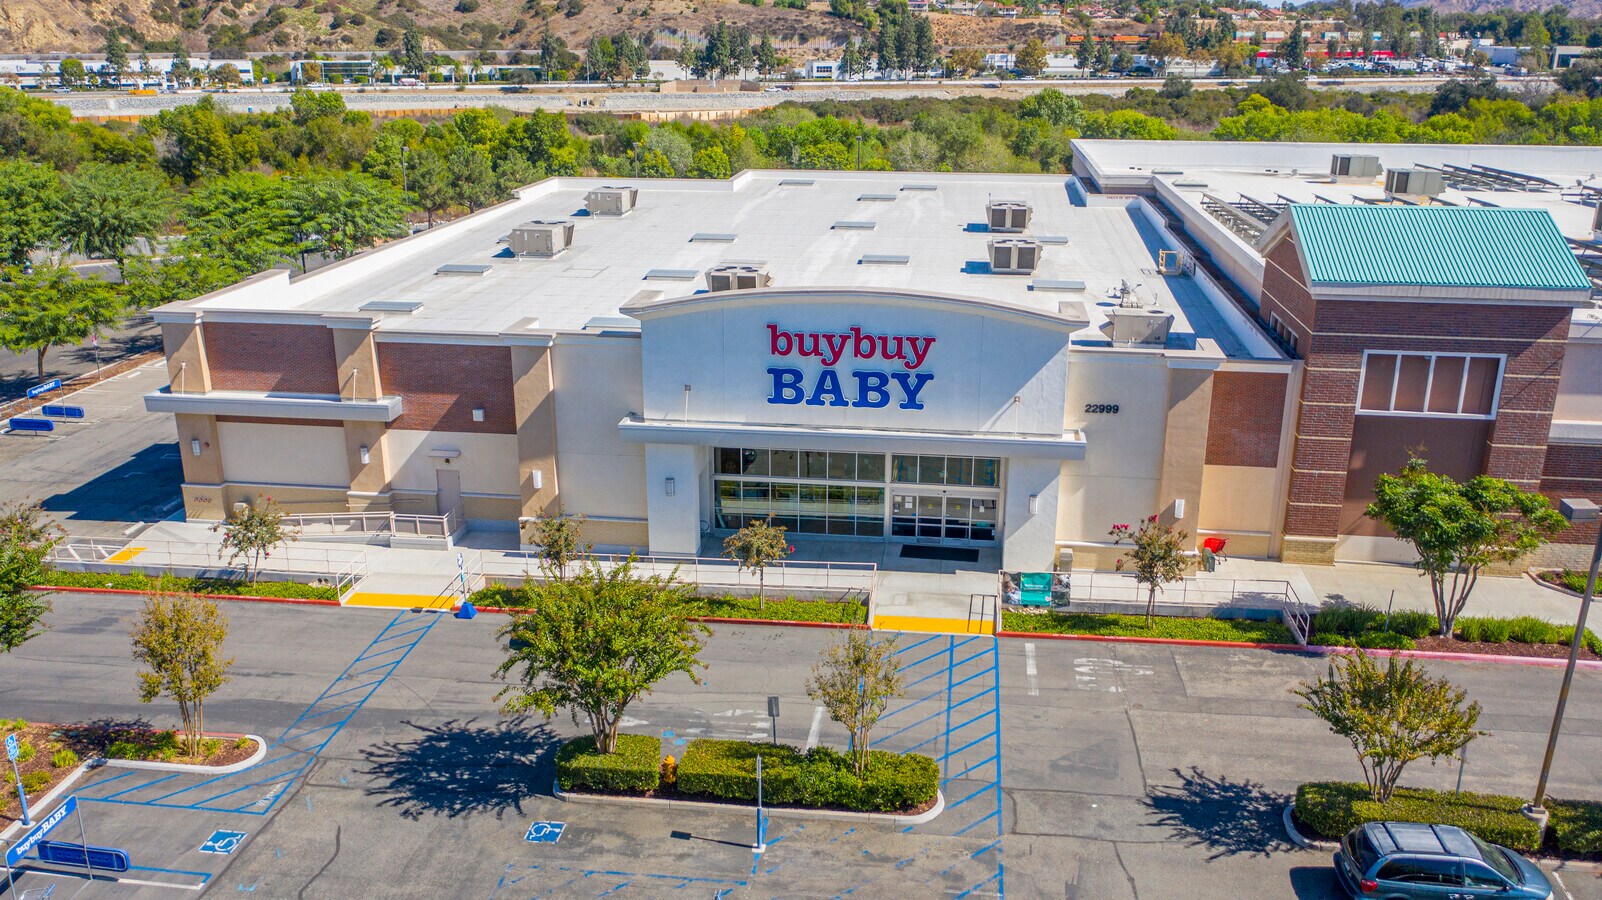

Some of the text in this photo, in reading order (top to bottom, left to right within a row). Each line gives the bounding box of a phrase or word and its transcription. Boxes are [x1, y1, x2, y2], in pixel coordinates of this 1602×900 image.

[766, 323, 937, 370] buybuy
[766, 367, 936, 411] BABY
[1084, 403, 1120, 414] 22999
[15, 804, 67, 855] buybuyBABY
